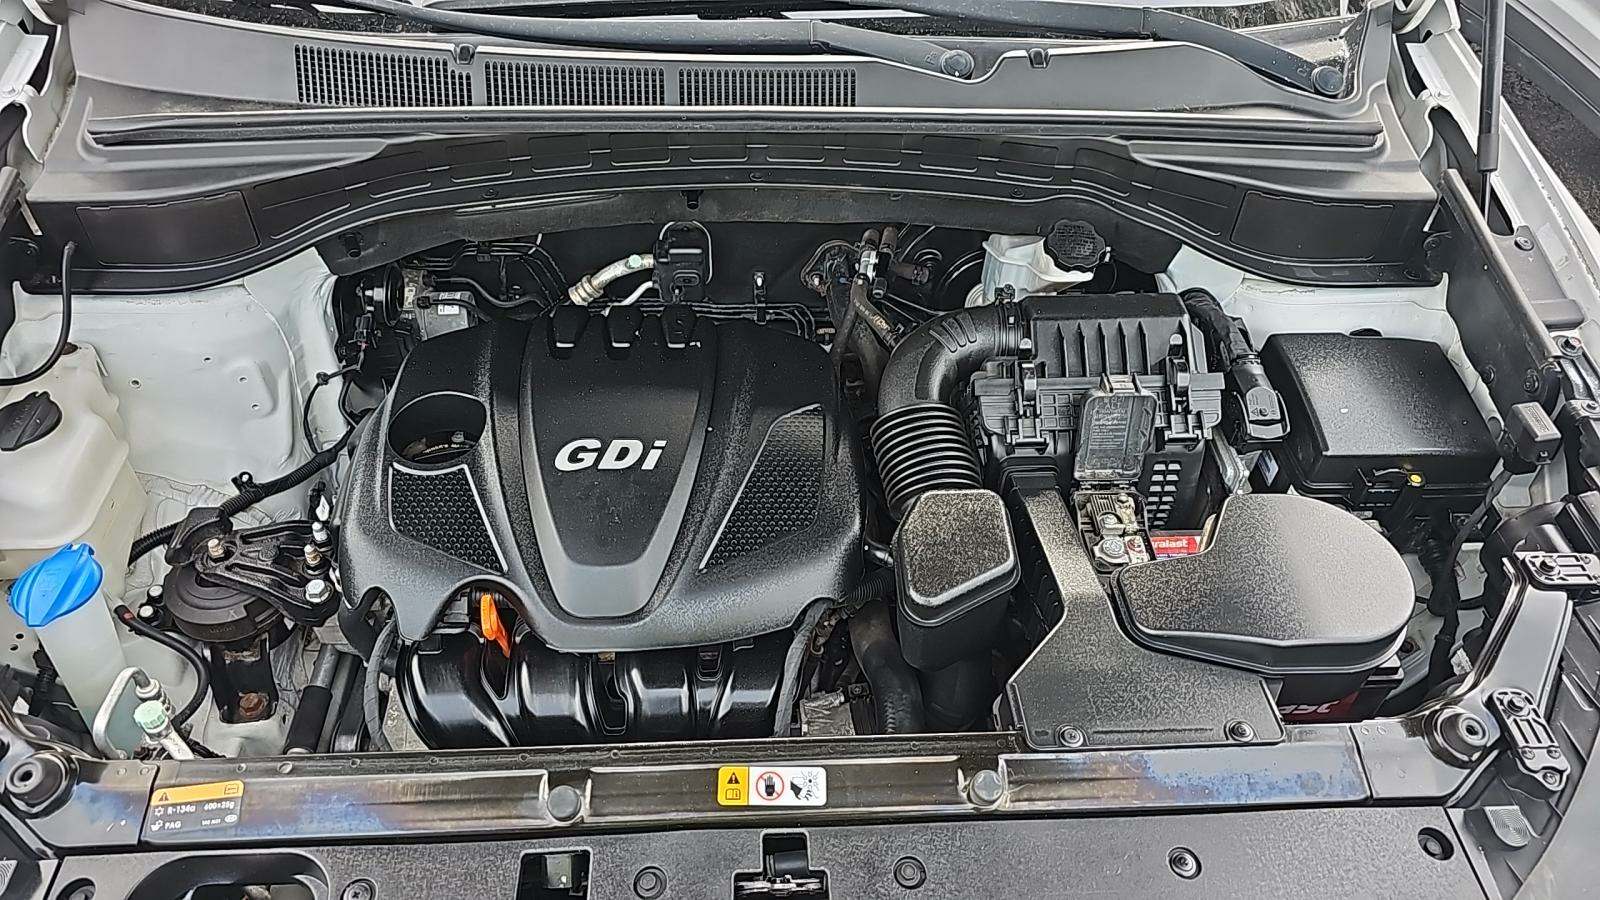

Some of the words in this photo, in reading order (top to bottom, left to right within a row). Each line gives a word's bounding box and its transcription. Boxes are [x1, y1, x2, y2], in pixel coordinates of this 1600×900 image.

[554, 439, 668, 472] GDi
[1153, 538, 1188, 548] ralast
[167, 804, 196, 815] R-134a
[164, 821, 182, 830] PAG
